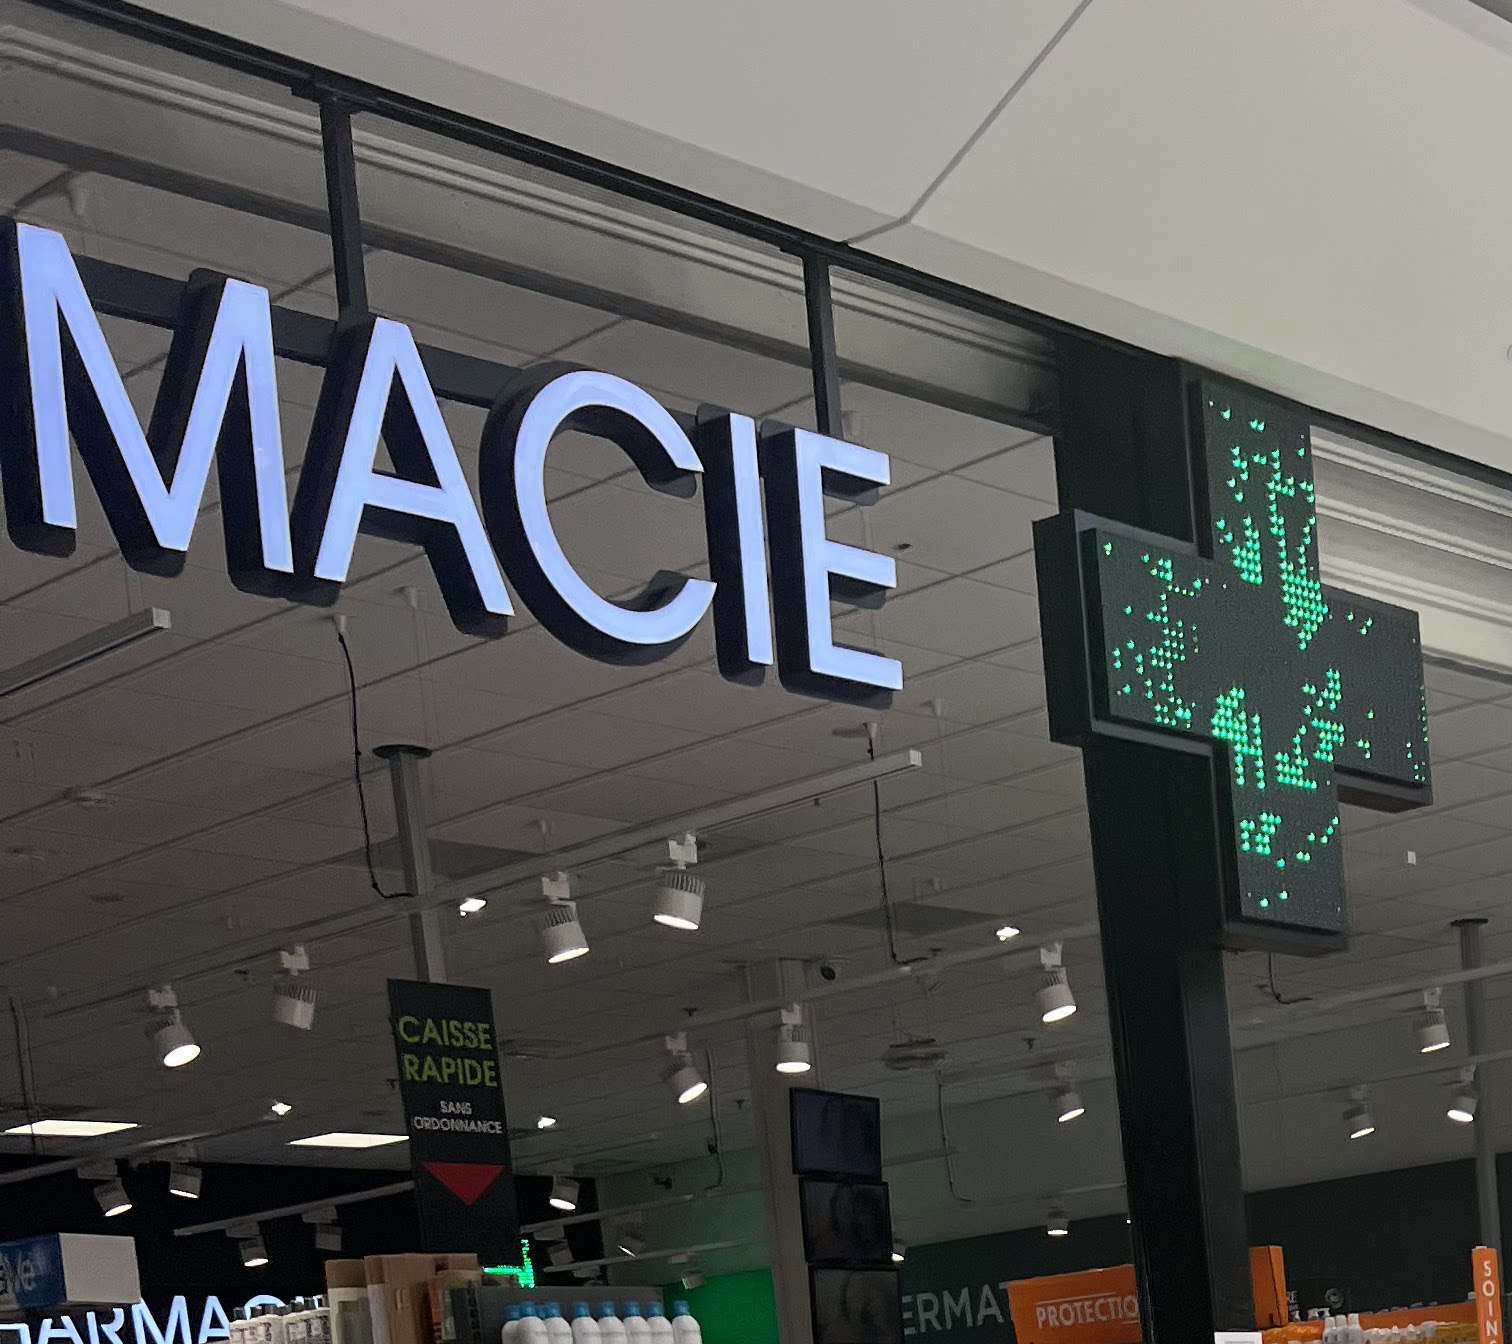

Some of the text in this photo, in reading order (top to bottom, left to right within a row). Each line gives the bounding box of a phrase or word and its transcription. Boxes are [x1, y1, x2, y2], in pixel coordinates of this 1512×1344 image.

[398, 1015, 494, 1050] CAISSE
[402, 1053, 498, 1088] RAPIDE
[412, 1116, 503, 1134] ORDONNANCE
[440, 1100, 473, 1115] SANS
[1036, 1294, 1139, 1330] PROTECTIO
